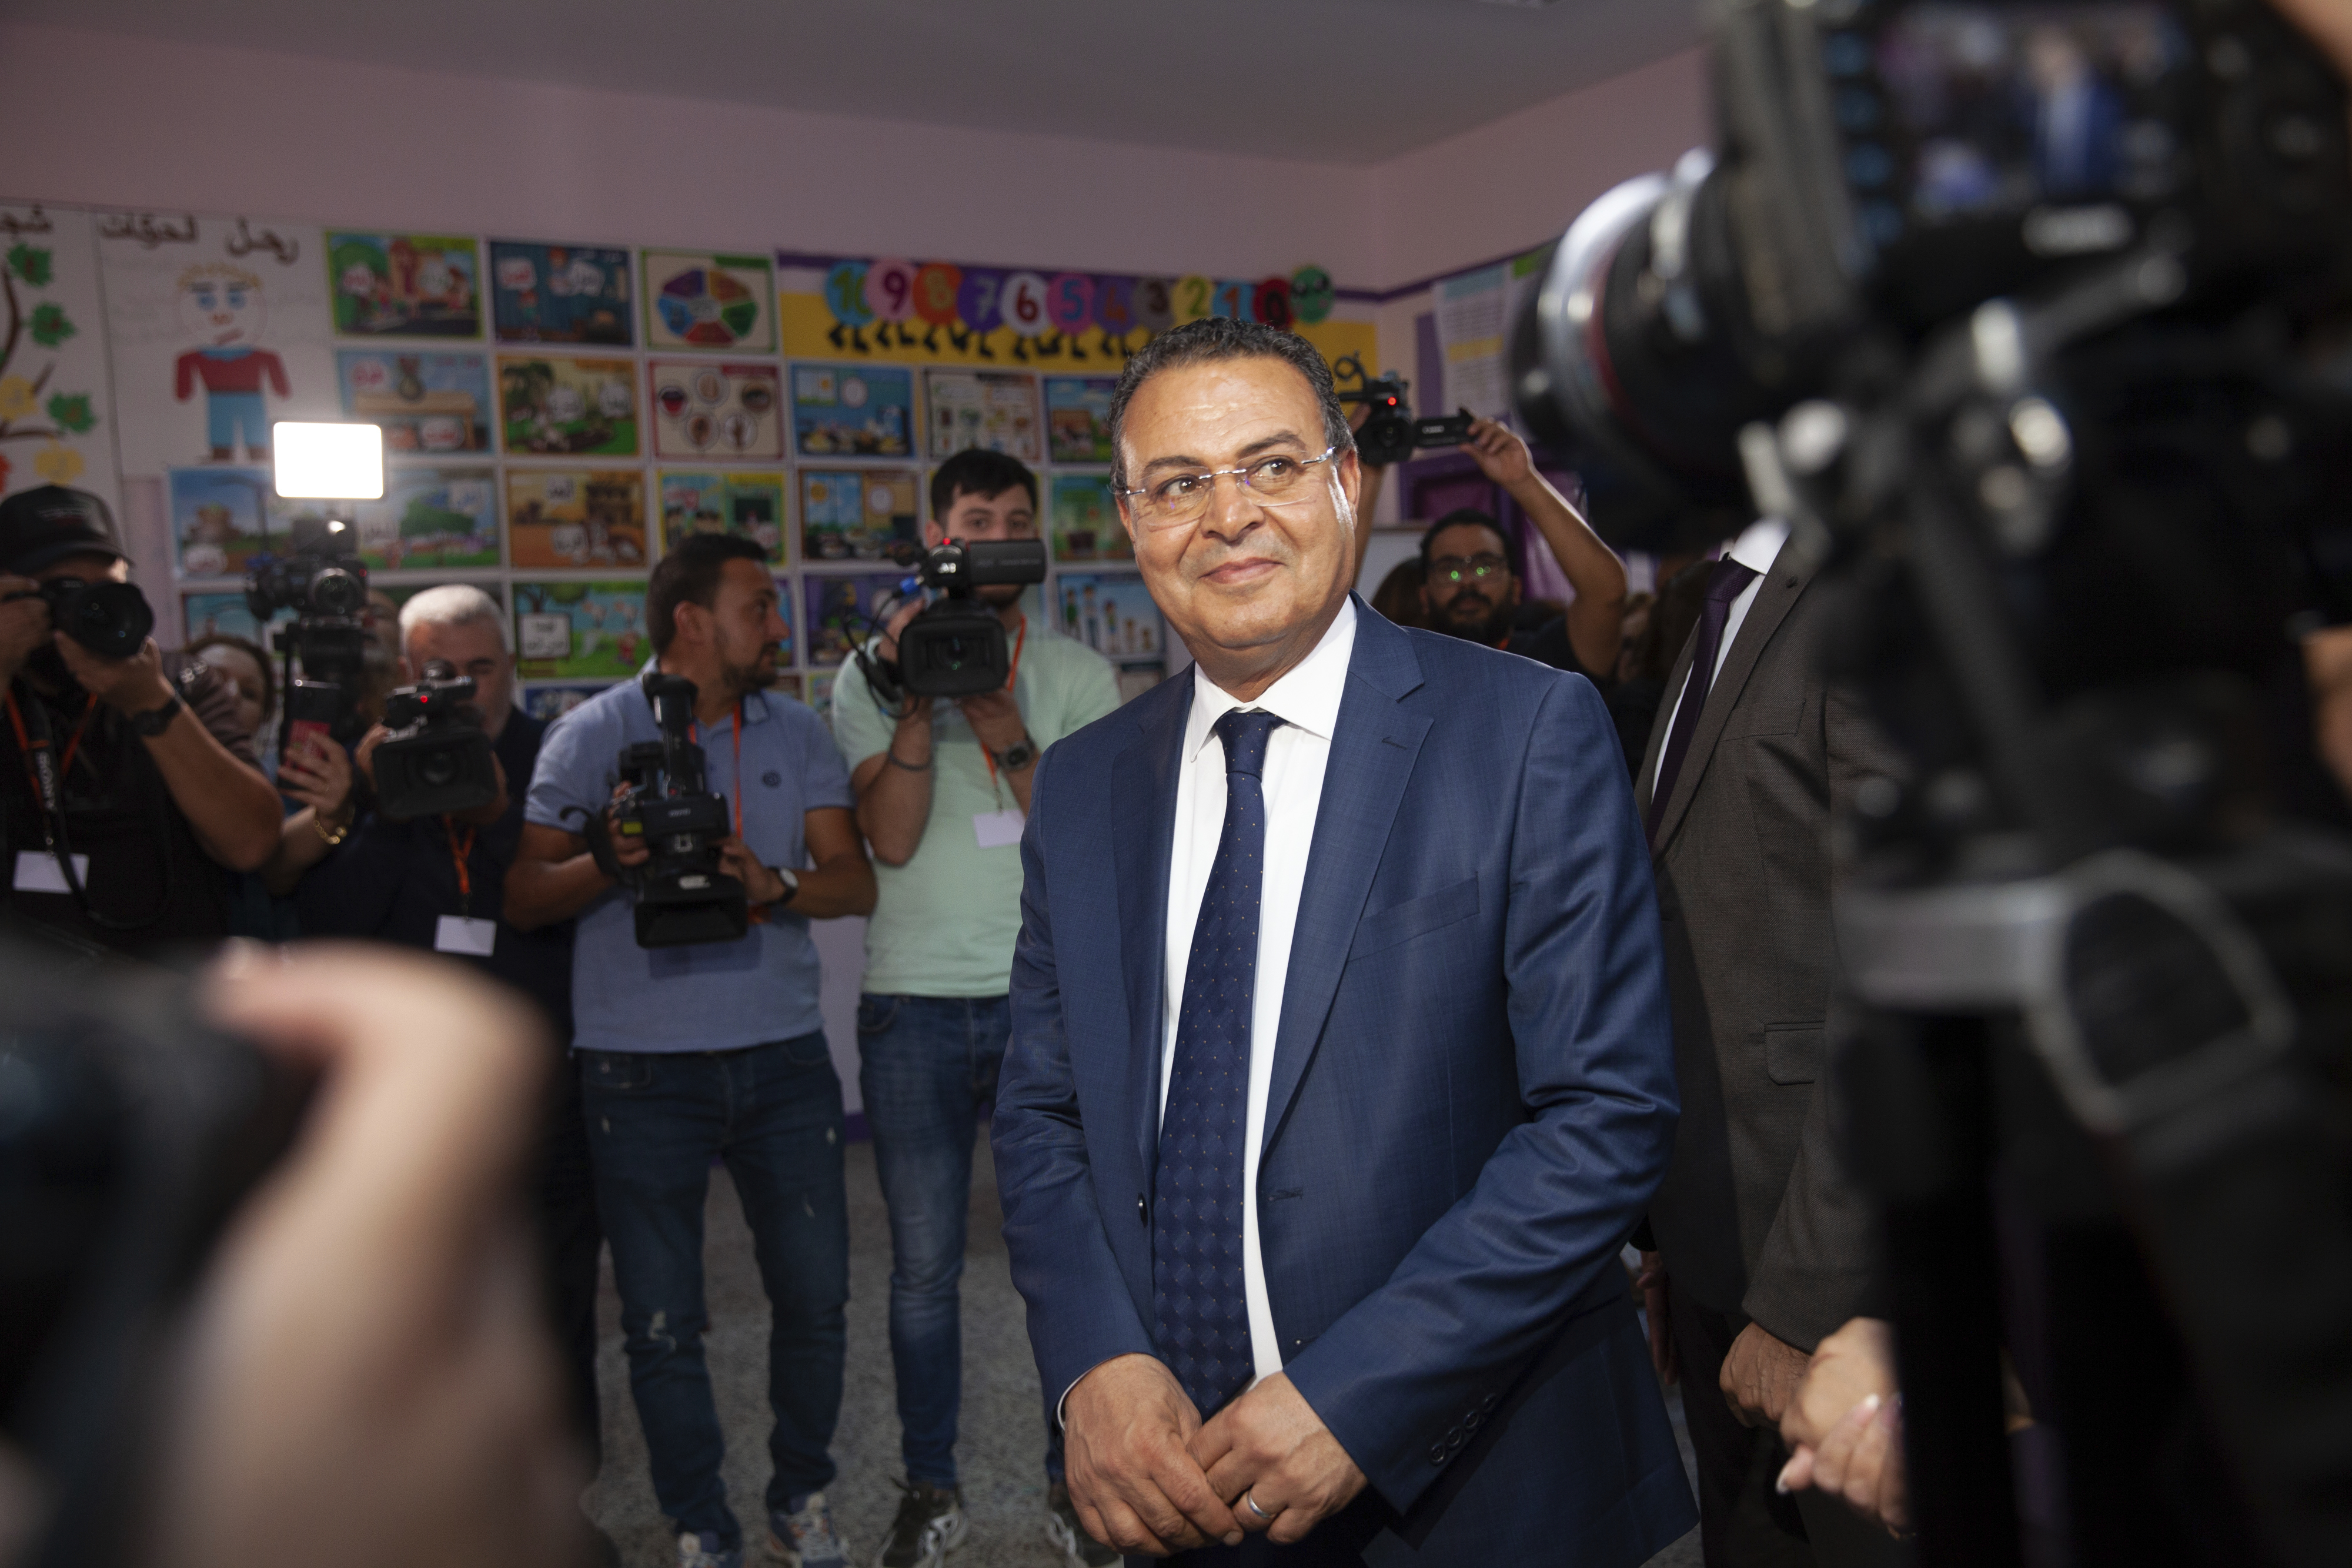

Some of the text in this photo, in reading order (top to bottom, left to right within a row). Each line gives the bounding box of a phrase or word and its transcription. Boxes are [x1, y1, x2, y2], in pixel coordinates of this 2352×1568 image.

[884, 269, 908, 314] 9
[926, 268, 953, 310] 8
[975, 276, 998, 323] 7
[1016, 282, 1038, 325] 6
[1063, 279, 1083, 320] 5
[1105, 287, 1127, 322] 4
[1147, 279, 1168, 315] 3
[1187, 277, 1207, 316] 2
[1225, 286, 1240, 318] 1
